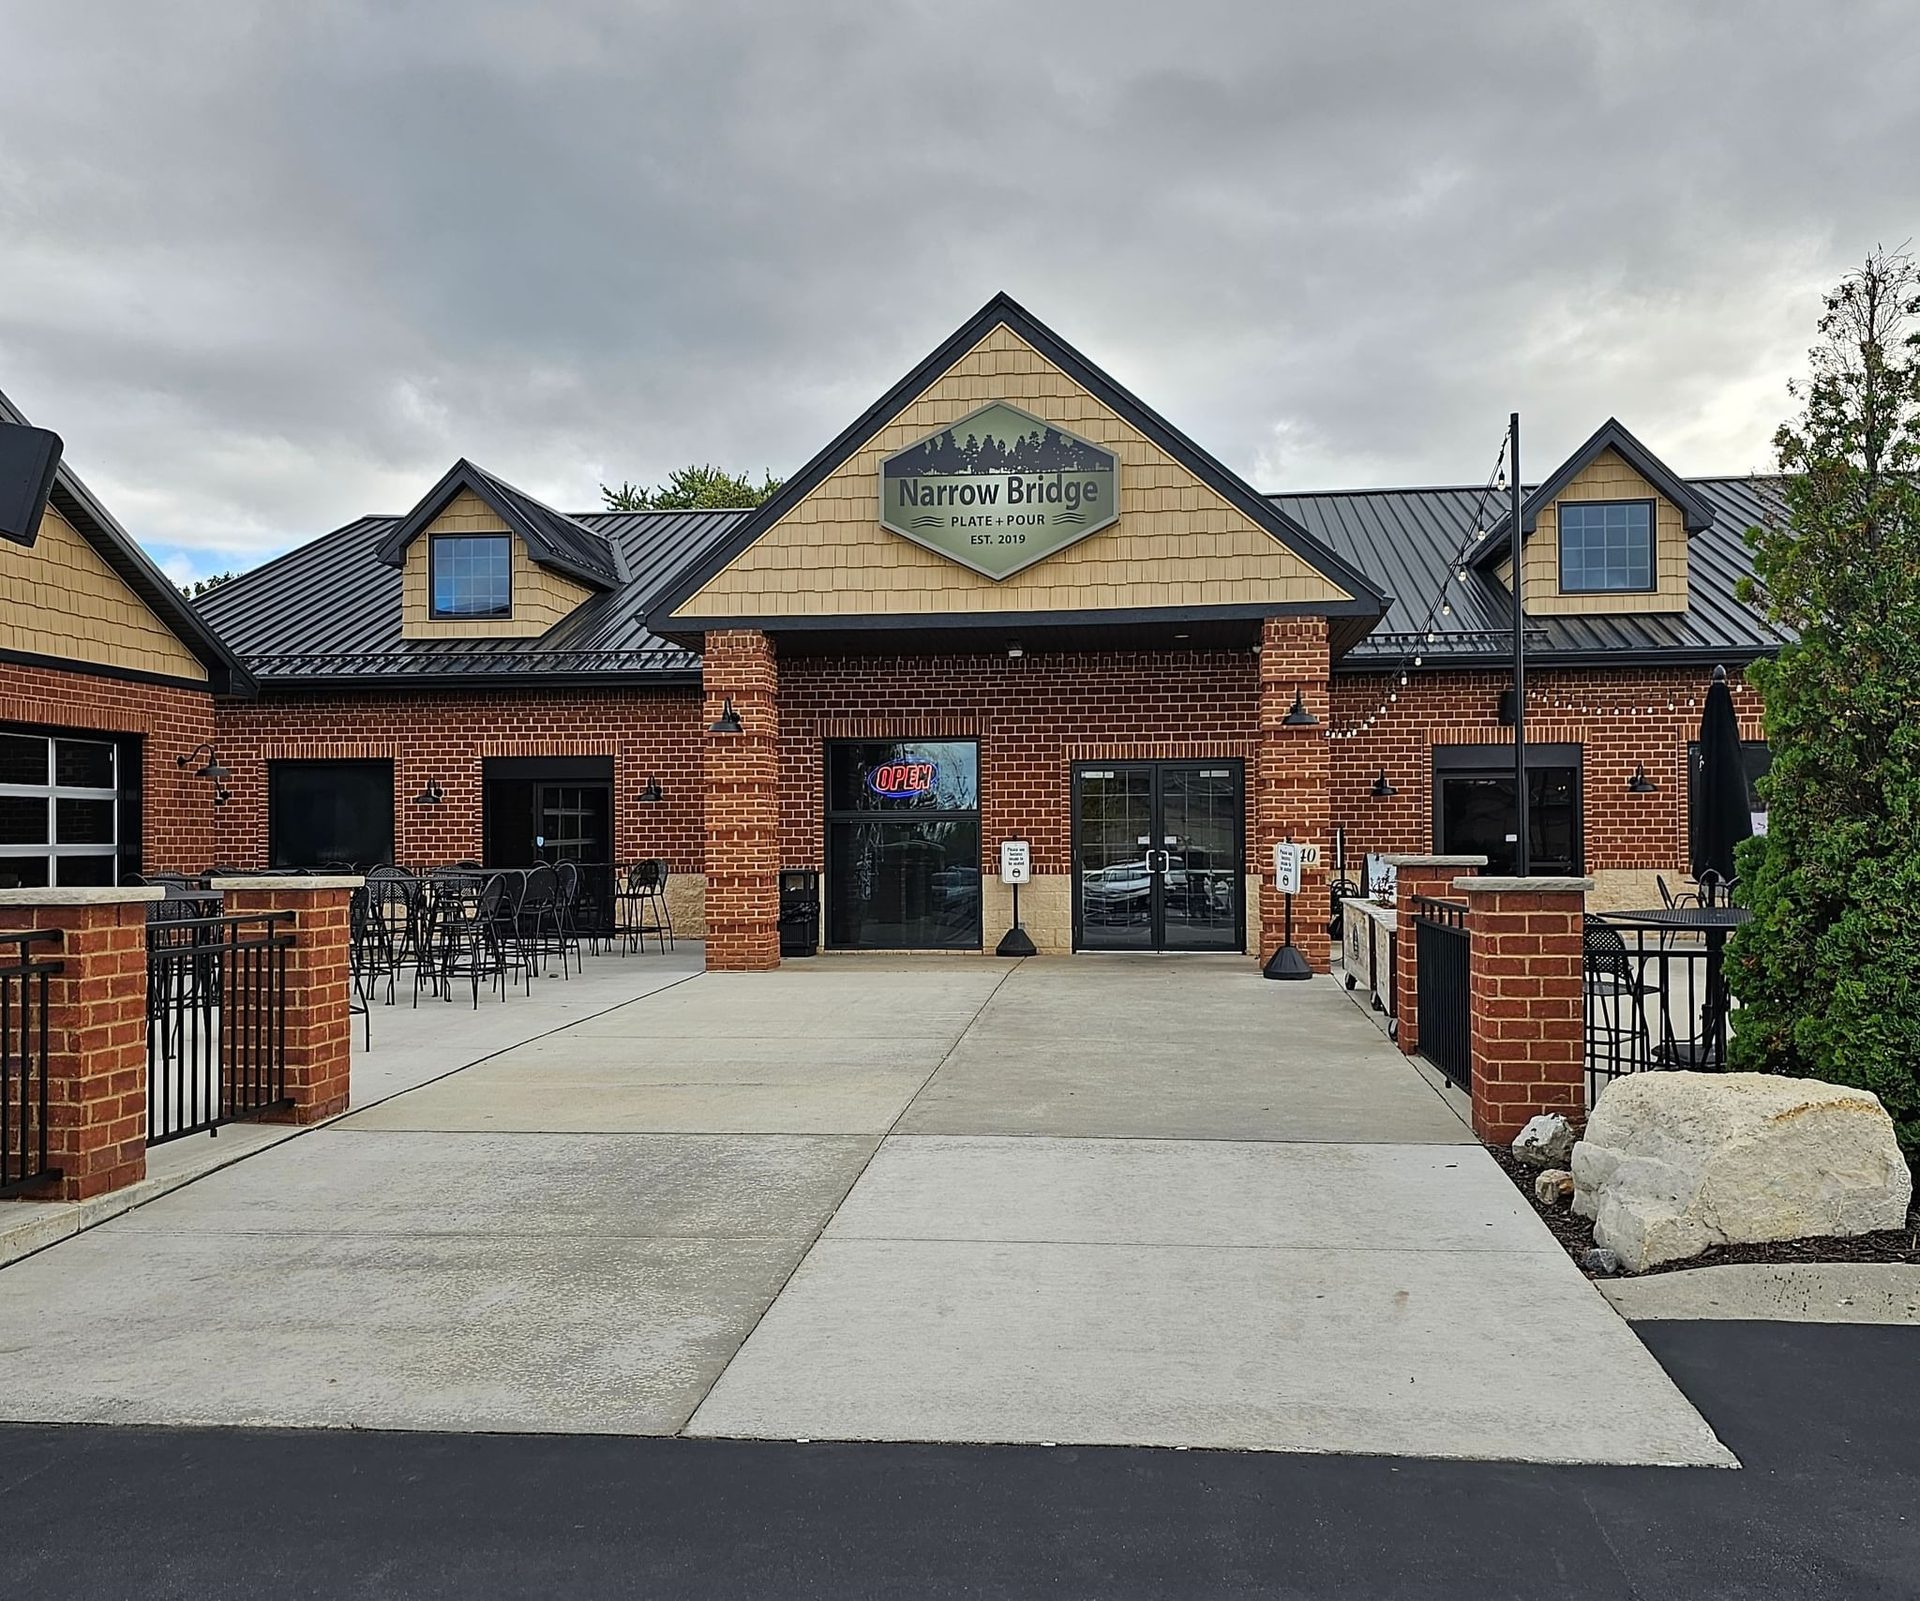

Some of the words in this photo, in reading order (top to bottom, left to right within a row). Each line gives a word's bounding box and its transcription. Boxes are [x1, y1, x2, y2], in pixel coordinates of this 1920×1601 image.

[899, 478, 999, 507] Narrow
[1007, 475, 1098, 510] Bridge
[951, 515, 993, 527] PLATE
[996, 517, 1004, 526] +
[1007, 514, 1046, 526] POUR
[970, 535, 993, 545] EST.
[998, 534, 1026, 544] 2019
[876, 764, 933, 791] OPEN
